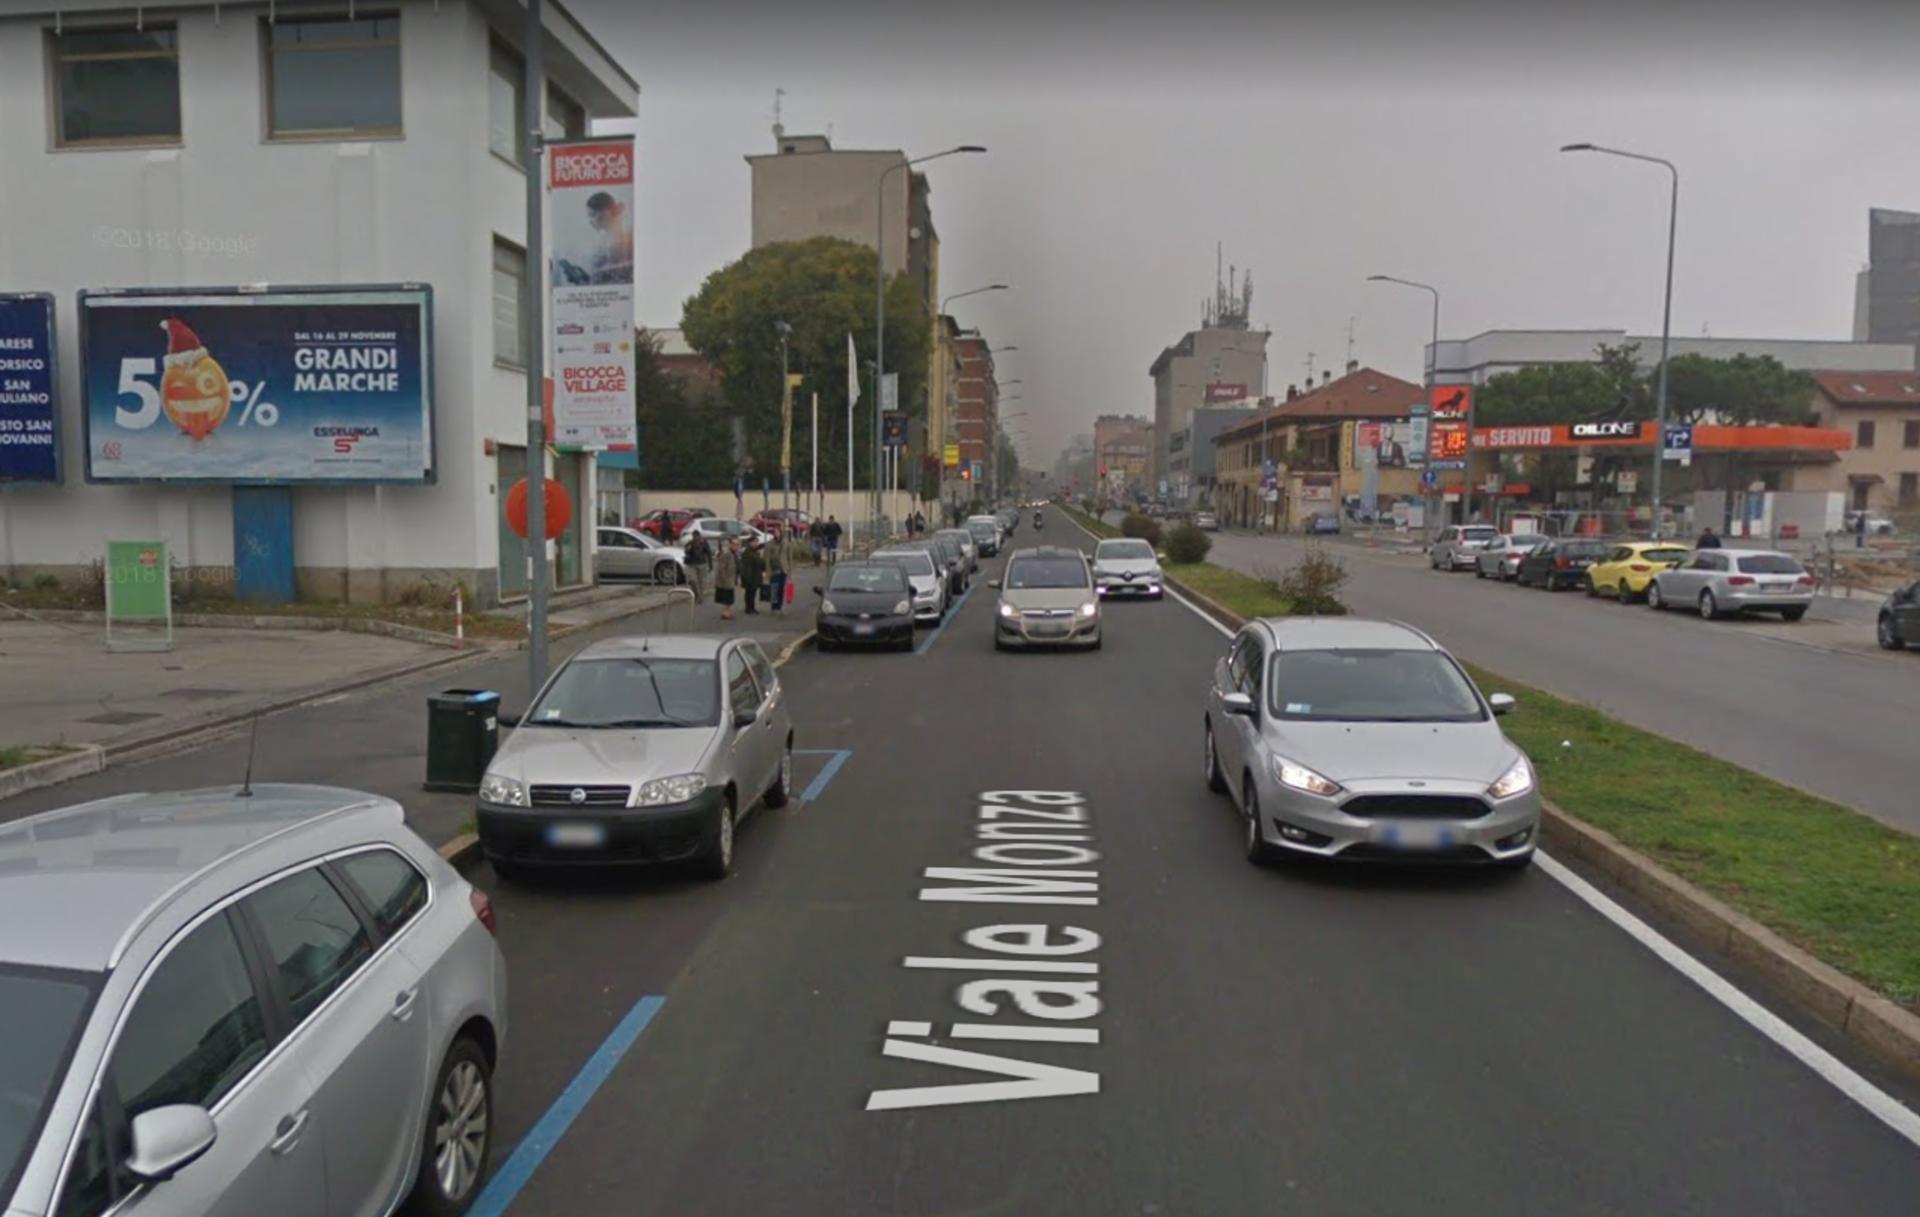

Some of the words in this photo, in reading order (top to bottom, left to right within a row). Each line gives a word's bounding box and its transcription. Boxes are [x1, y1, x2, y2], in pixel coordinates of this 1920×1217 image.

[350, 332, 397, 340] NOVEMBRE
[294, 347, 397, 370] GRANDI
[564, 366, 625, 379] BICOCCA
[4, 380, 30, 391] SAN
[294, 372, 399, 391] MARCHE
[564, 379, 626, 392] VILLAGE
[25, 420, 52, 431] SAN
[1573, 422, 1635, 436] OILONE
[1490, 427, 1551, 447] SERVITO
